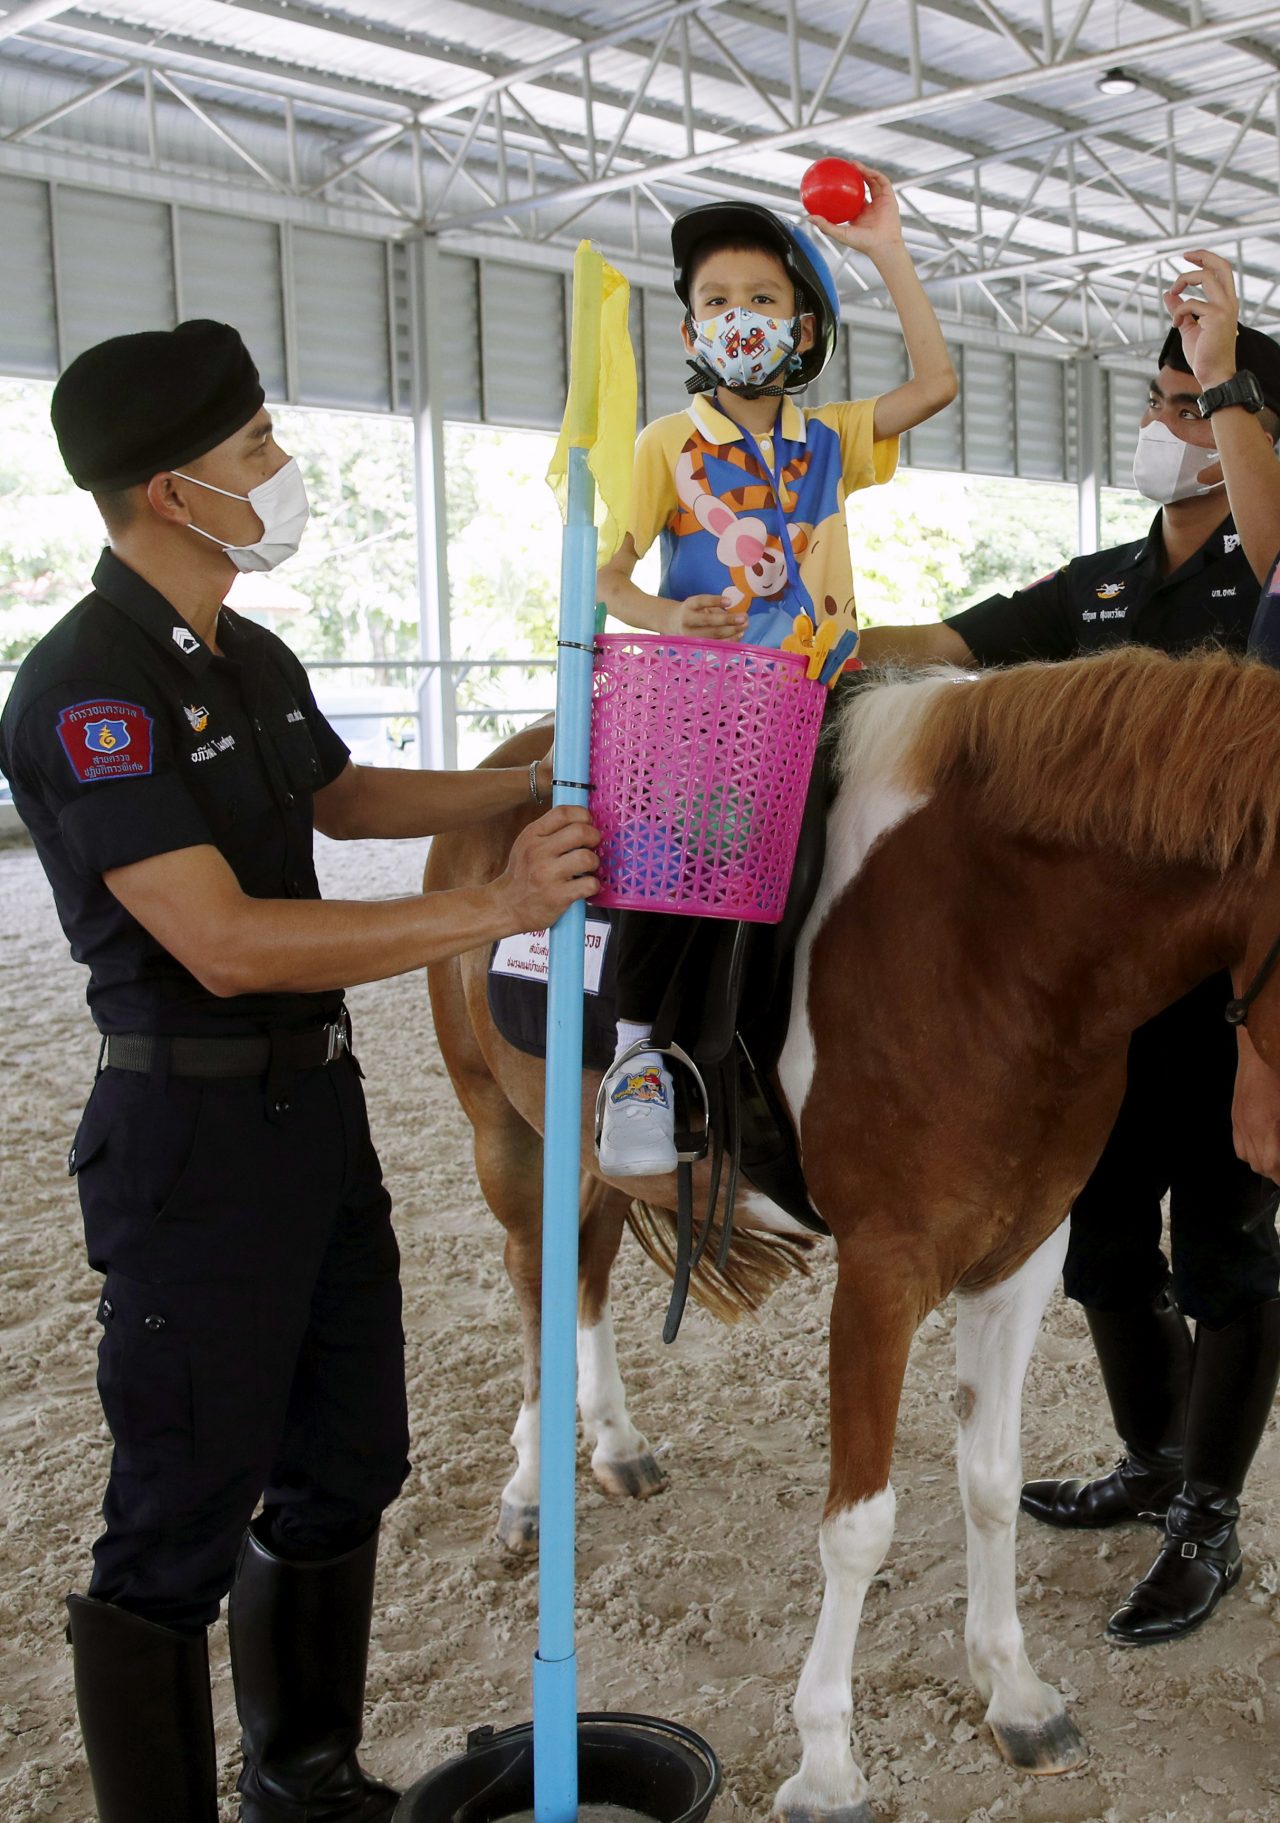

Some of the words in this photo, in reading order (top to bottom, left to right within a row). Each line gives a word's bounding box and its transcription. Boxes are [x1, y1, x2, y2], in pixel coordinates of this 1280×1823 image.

[68, 704, 138, 723] ตำรวจนครบาล
[92, 753, 131, 766] สายตรวจ
